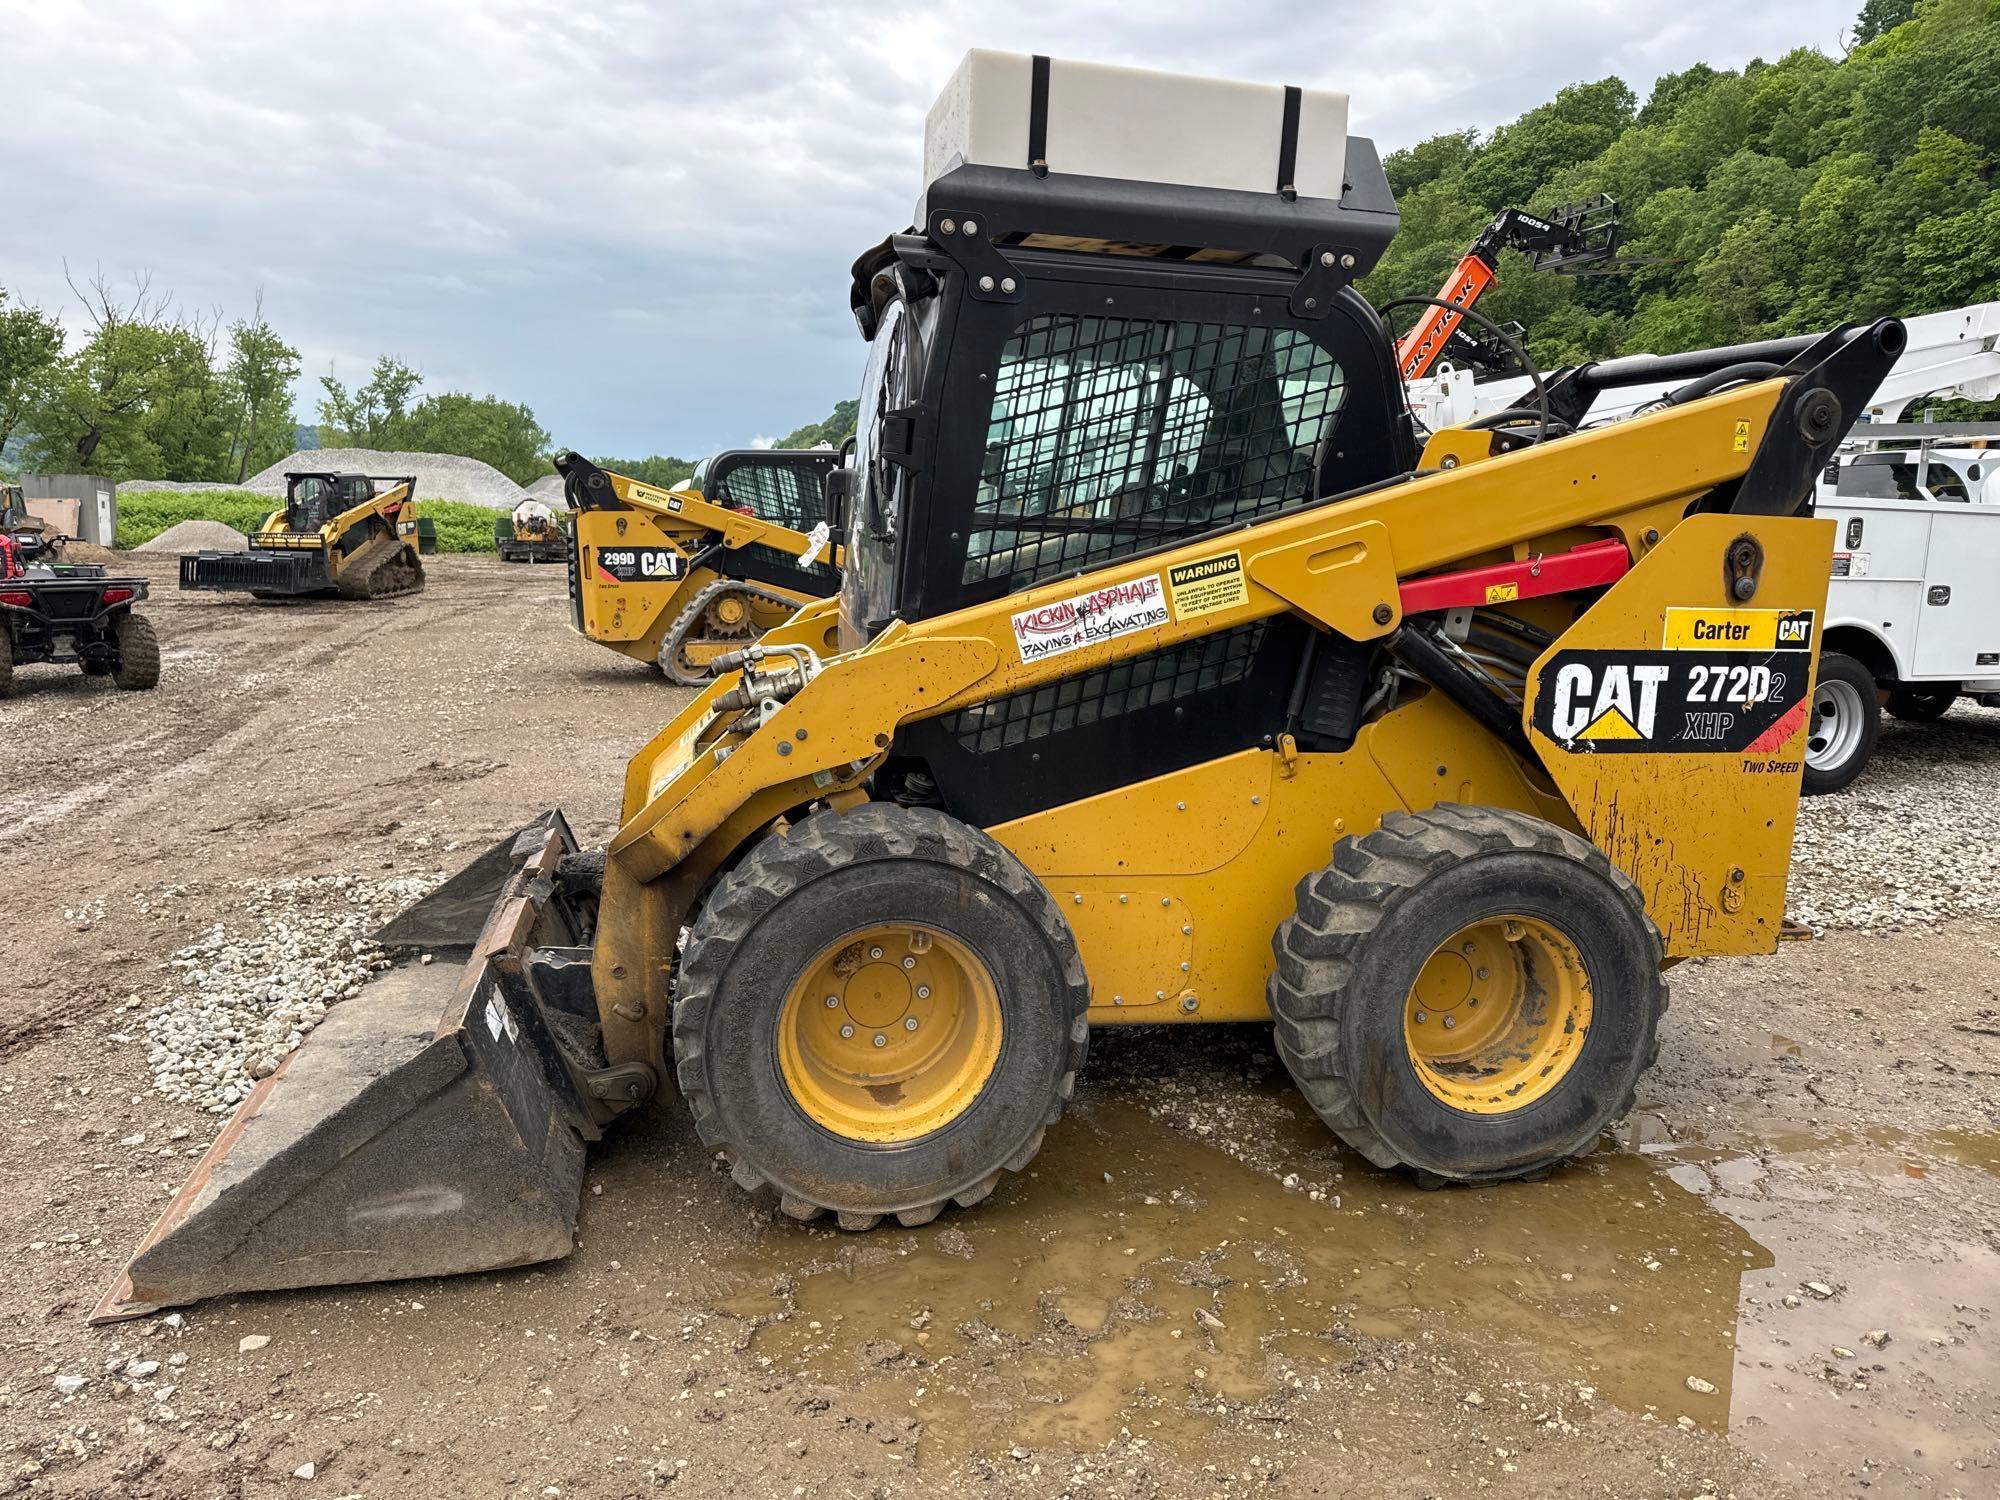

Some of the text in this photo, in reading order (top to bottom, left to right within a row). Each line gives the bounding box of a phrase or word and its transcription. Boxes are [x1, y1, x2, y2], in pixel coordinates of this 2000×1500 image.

[1517, 214, 1551, 232] 10054
[669, 499, 682, 510] CAT
[604, 552, 635, 565] 299D
[640, 552, 679, 576] CAT
[1174, 558, 1237, 583] WARNING
[1176, 586, 1207, 597] UNLAWFUL
[1215, 577, 1241, 588] OPERATE
[1176, 582, 1243, 603] THIS EQUIPMENT WITHIN
[1188, 598, 1203, 607] FEET
[1211, 589, 1241, 600] OVERHEAD
[1016, 578, 1159, 638] KICKIN ASPHALT
[1223, 595, 1240, 604] LINES
[1022, 634, 1072, 657] PAVING
[1084, 607, 1168, 639] EXCAVATING
[1693, 619, 1750, 641] Carter
[1778, 620, 1811, 642] CAT
[1551, 663, 1669, 741] CAT
[1682, 712, 1735, 740] XHP
